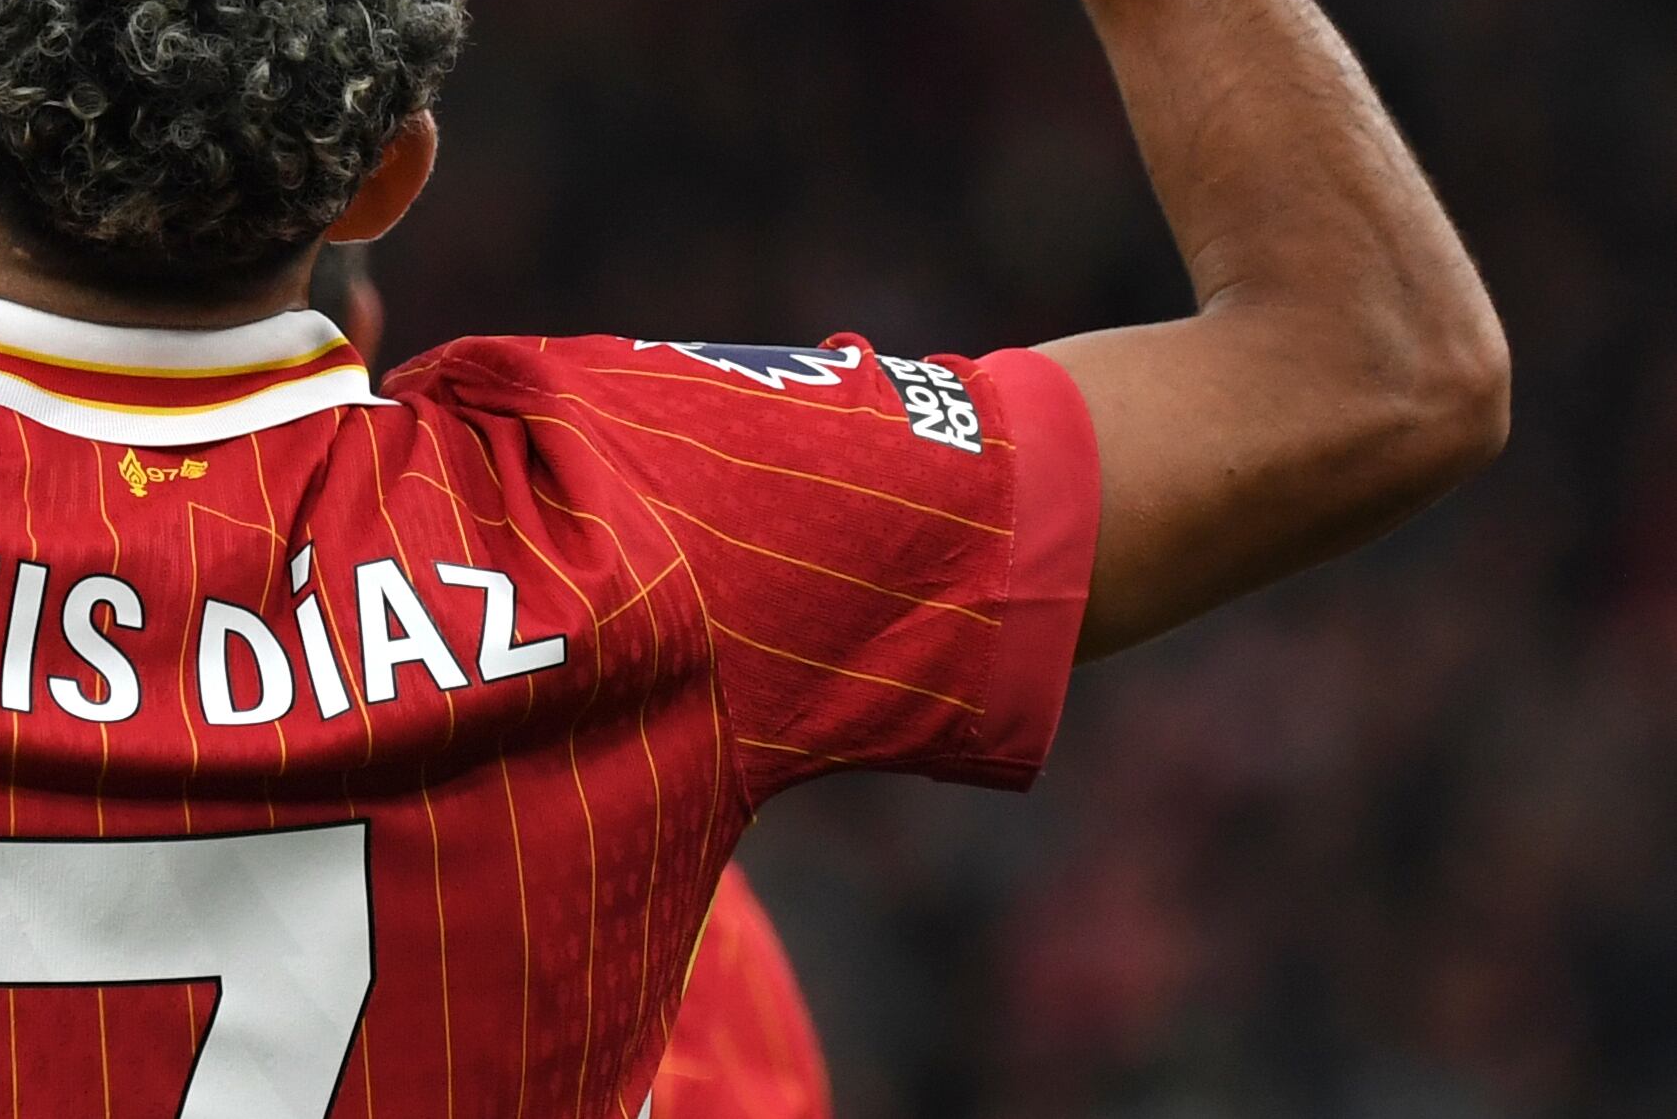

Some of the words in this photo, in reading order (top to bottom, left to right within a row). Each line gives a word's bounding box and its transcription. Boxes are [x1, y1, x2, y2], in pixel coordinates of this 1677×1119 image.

[905, 385, 950, 444] No
[938, 390, 982, 453] For
[146, 467, 179, 483] 97
[198, 543, 566, 727] DÍAZ
